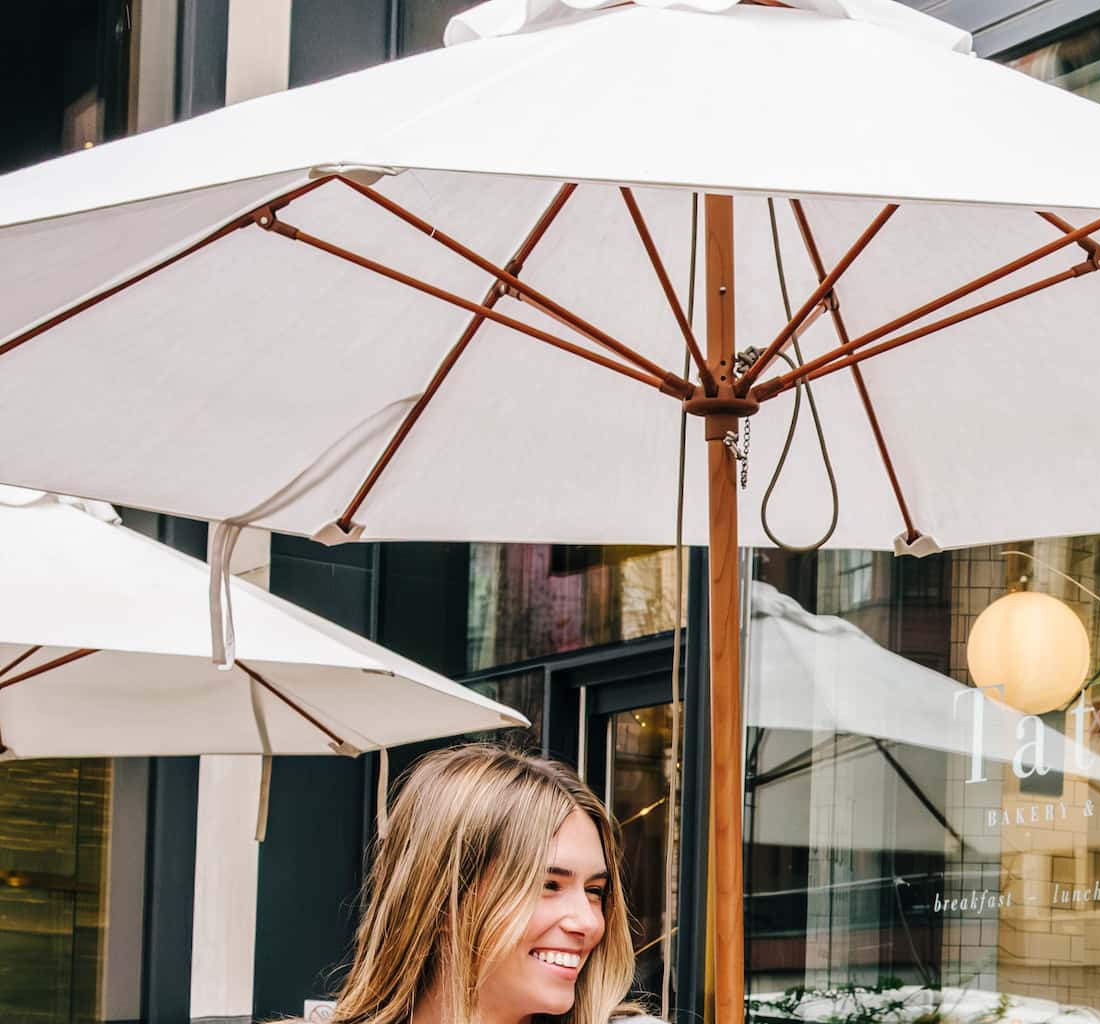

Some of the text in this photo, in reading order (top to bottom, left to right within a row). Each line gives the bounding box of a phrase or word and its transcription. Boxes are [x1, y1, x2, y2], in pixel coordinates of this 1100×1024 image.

[987, 800, 1069, 828] BAKERY
[1082, 799, 1095, 817] &
[933, 888, 1013, 915] breakfast
